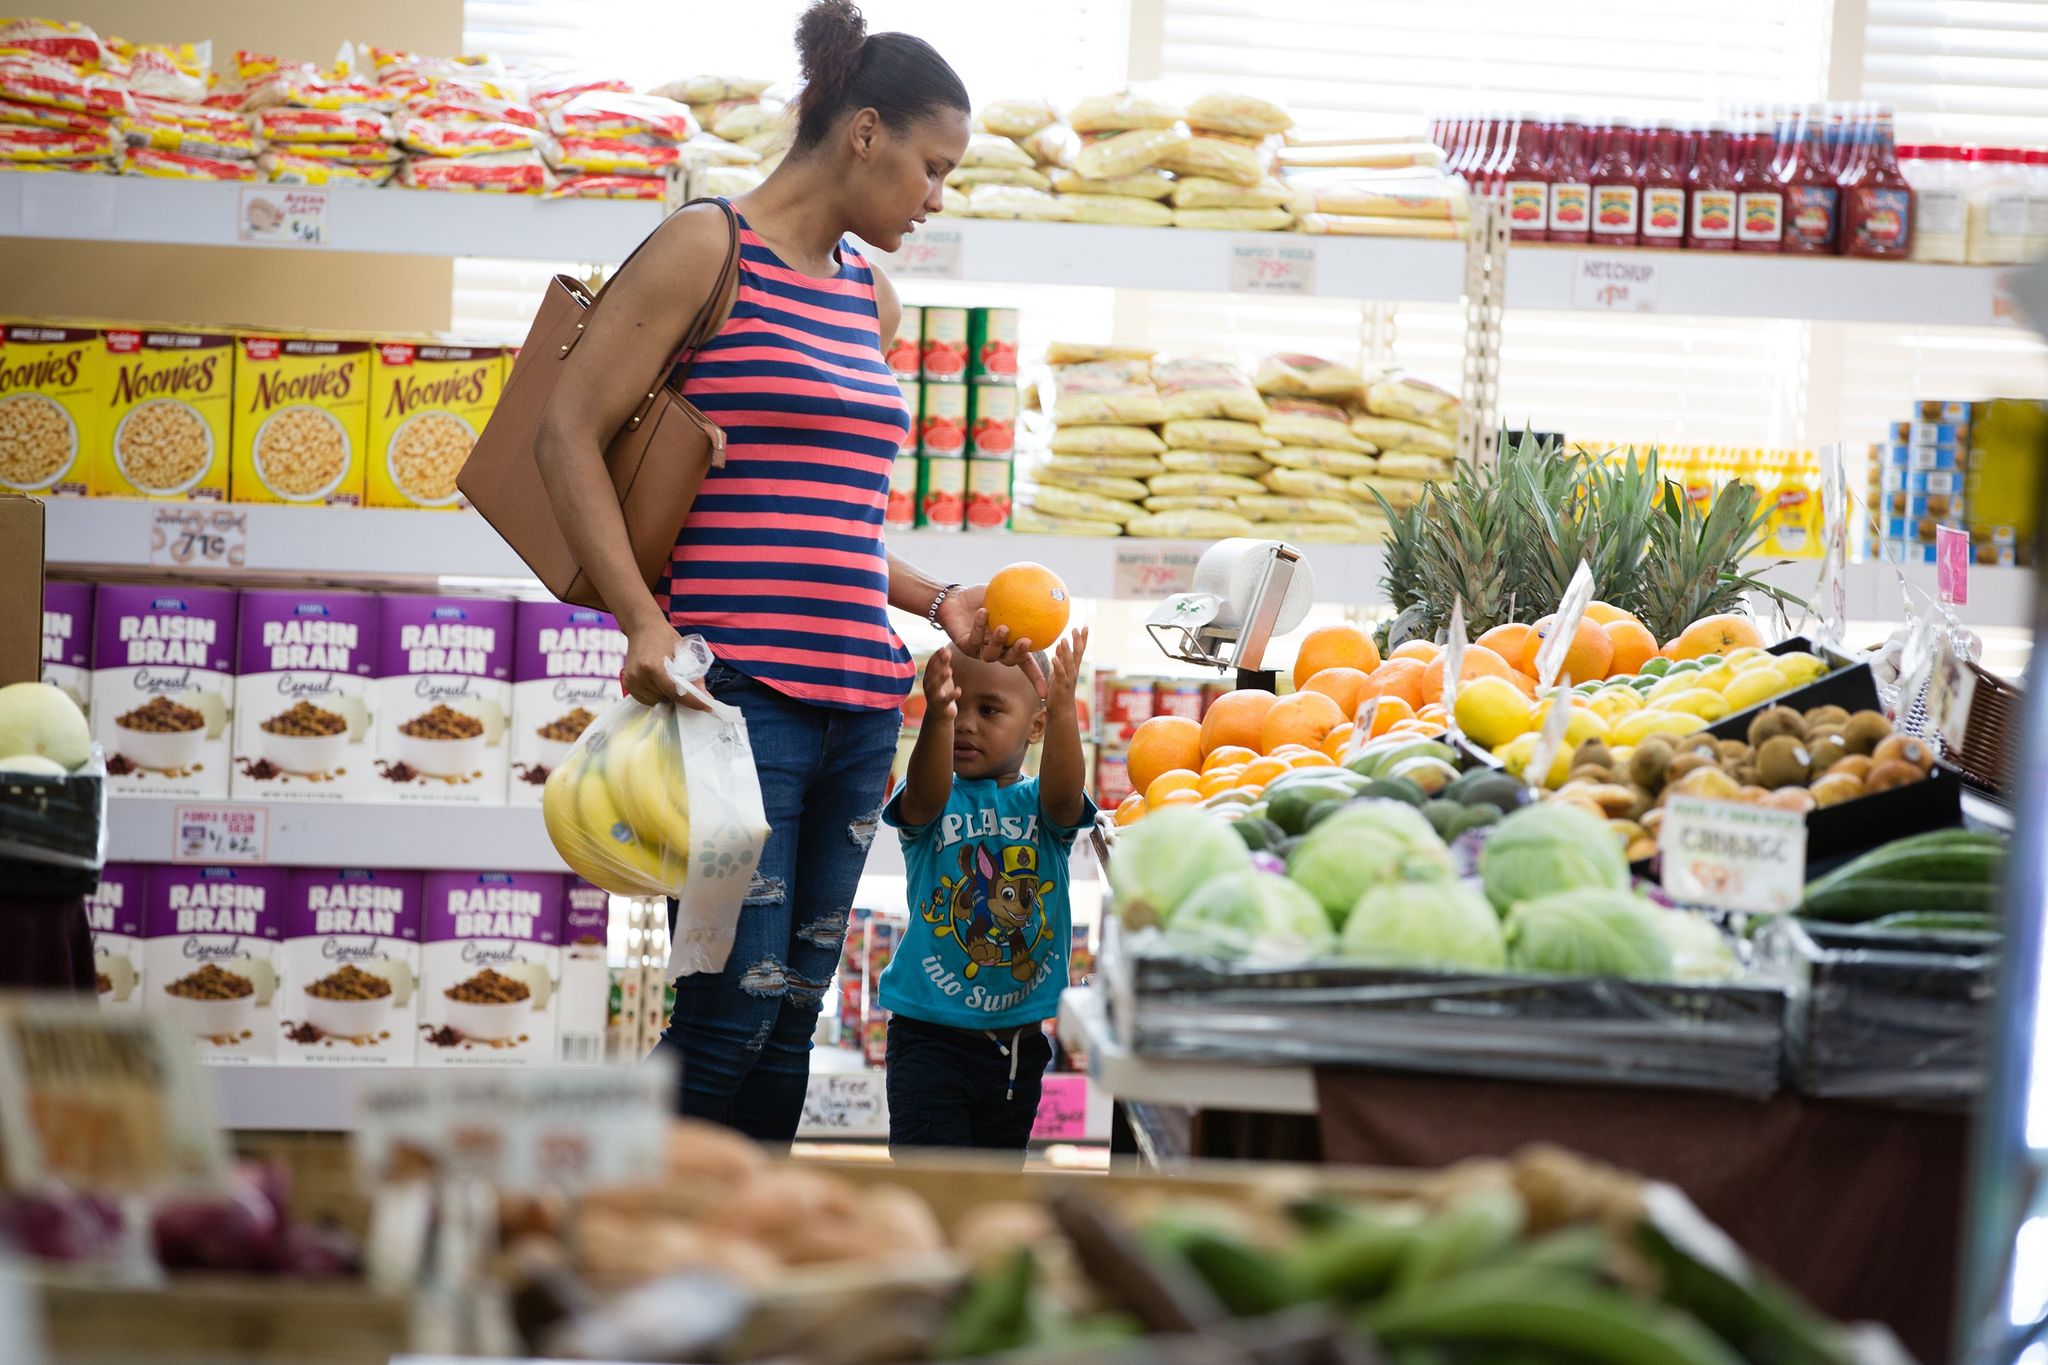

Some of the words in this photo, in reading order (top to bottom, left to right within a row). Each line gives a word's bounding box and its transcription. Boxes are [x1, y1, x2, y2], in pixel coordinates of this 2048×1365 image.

[119, 615, 216, 646] RAISIN
[263, 620, 358, 649] RAISIN
[401, 624, 495, 653] RAISIN
[538, 627, 629, 655] RAISIN
[127, 640, 207, 667] BRAN
[271, 645, 350, 671] BRAN
[408, 648, 487, 675] BRAN
[547, 651, 627, 677] BRAN
[133, 668, 200, 691] Cereal
[277, 672, 341, 695] Cereal
[415, 678, 478, 700] Cereal
[553, 681, 612, 701] Cereal
[169, 883, 266, 912] RAISIN
[307, 884, 403, 913] RAISIN
[448, 888, 542, 917] RAISIN
[176, 908, 256, 934] BRAN
[315, 910, 396, 936] BRAN
[455, 913, 533, 938] BRAN
[182, 937, 245, 960] Cereal
[321, 937, 386, 960] Cereal
[461, 942, 525, 963] Cereal
[921, 953, 962, 996] into
[829, 1077, 868, 1096] Free
